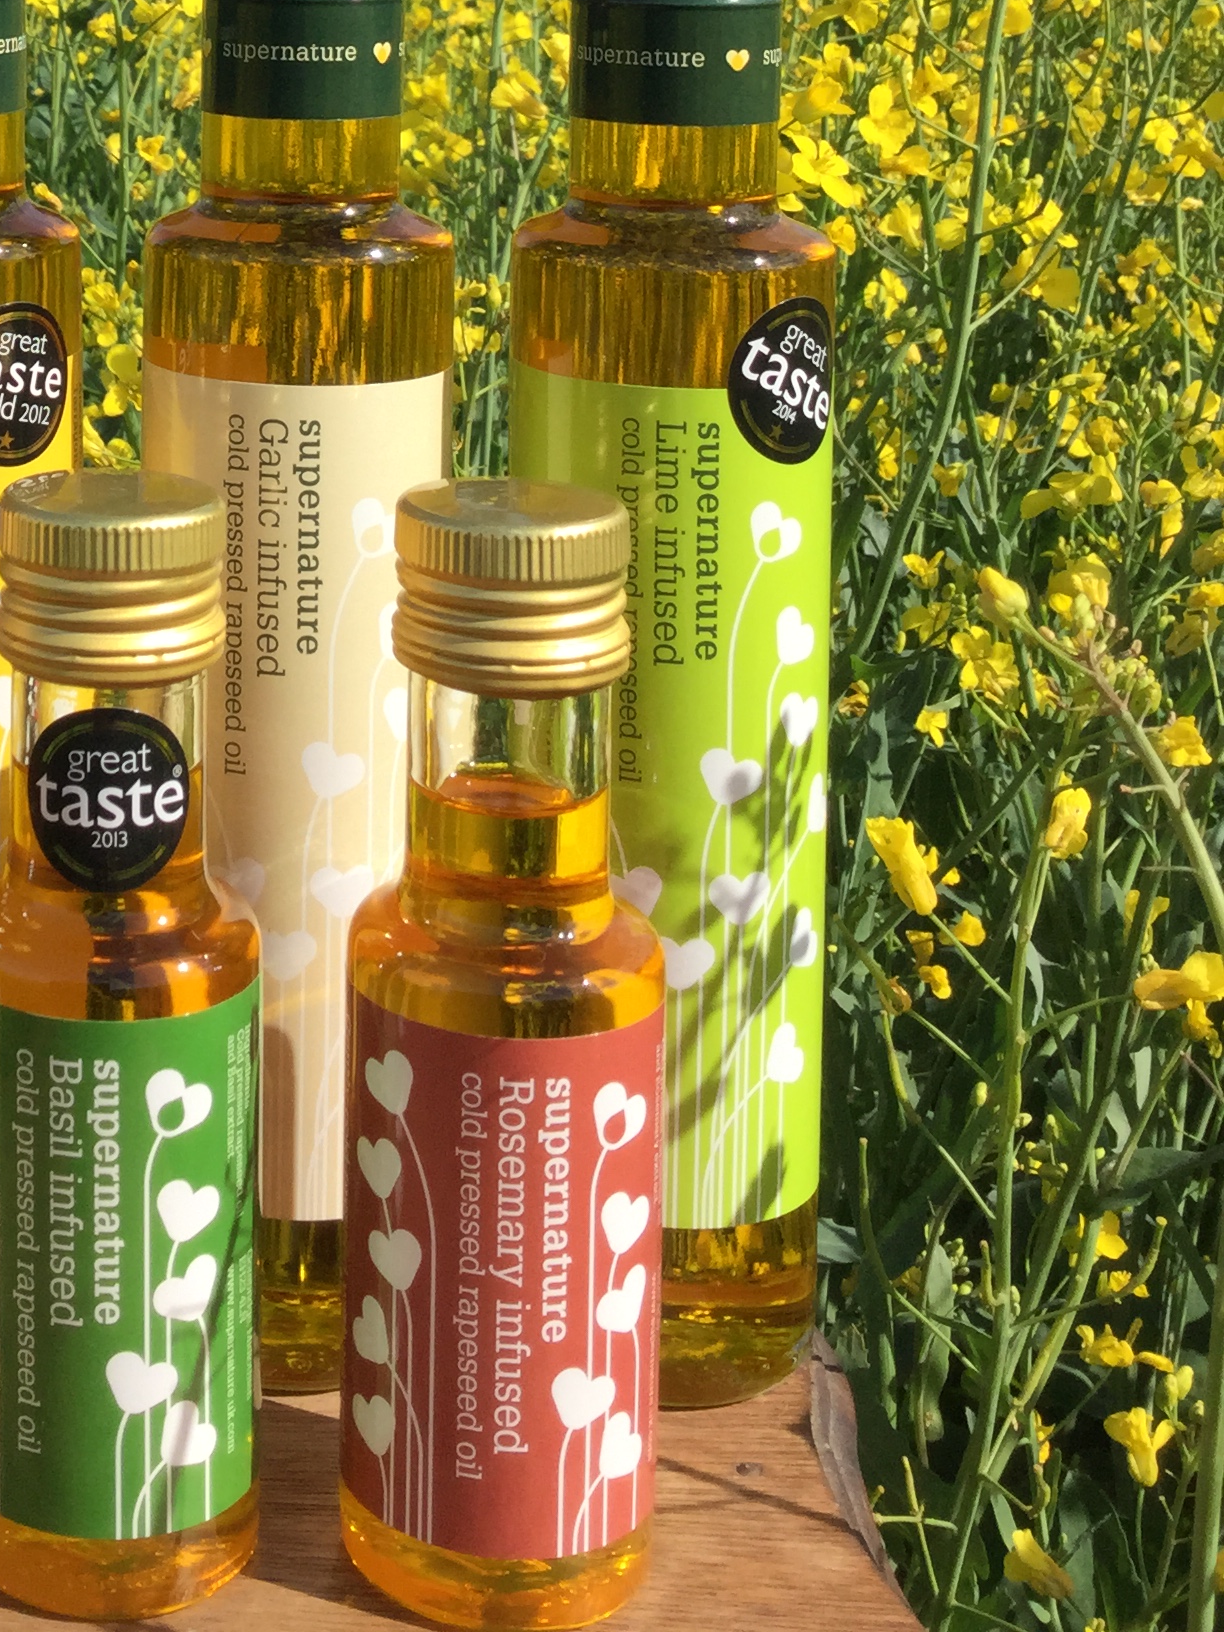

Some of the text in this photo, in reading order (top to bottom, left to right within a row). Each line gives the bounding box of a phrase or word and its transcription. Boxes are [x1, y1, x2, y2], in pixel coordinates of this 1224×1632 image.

[223, 41, 357, 62] supernature
[577, 44, 706, 68] supernature
[19, 403, 50, 426] 2012
[742, 336, 829, 430] taste
[772, 400, 797, 425] 2014
[780, 324, 827, 372] great
[621, 418, 645, 475] cold
[223, 414, 249, 775] cold pressed rapeseed oil
[256, 419, 289, 677] Garlic infused
[293, 420, 323, 654] supernature
[653, 420, 687, 666] Lime infused
[691, 422, 722, 660] supernature
[36, 772, 184, 829] taste
[67, 743, 152, 782] great
[91, 830, 128, 848] 2013
[619, 748, 642, 783] oil
[12, 1048, 42, 1454] cold pressed rapeseed oil
[49, 1055, 84, 1327] Basil infused
[87, 1059, 124, 1324] supernature
[489, 1076, 534, 1455] Rosemary infused
[538, 1077, 572, 1343] supernature
[453, 1072, 488, 1480] cold pressed rapeseed oil
